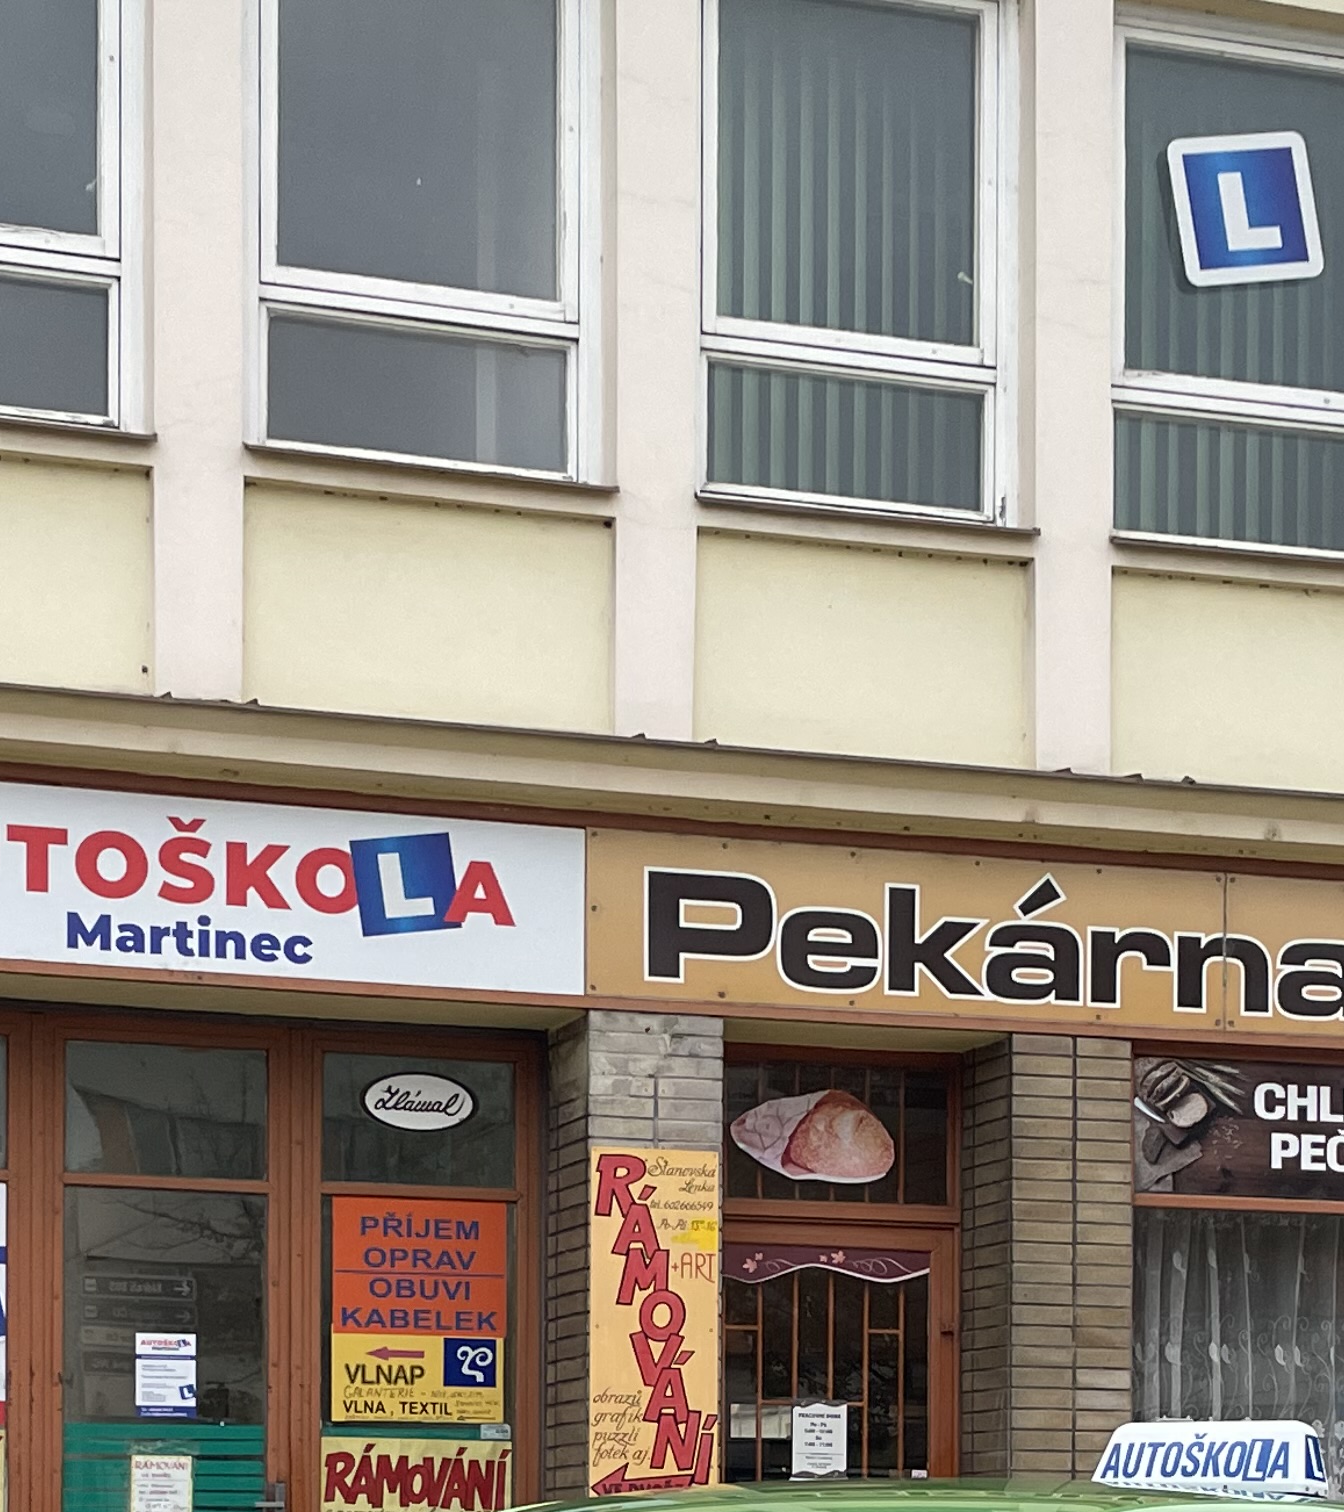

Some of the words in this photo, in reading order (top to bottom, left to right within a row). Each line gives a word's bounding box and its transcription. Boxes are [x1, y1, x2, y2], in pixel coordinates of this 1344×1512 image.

[1217, 172, 1282, 251] L
[67, 912, 313, 965] Martinec
[678, 1179, 716, 1195] Lenka
[360, 1212, 479, 1240] PŘÍJEM
[363, 1247, 476, 1271] OPRAV
[369, 1278, 471, 1300] OBUVI
[341, 1307, 497, 1331] KABELEK
[344, 1363, 425, 1386] VLNAP
[343, 1400, 386, 1414] VLNA
[399, 1401, 453, 1415] TEXTIL
[593, 1387, 643, 1407] obrazů
[591, 1406, 644, 1431] grafik
[593, 1441, 629, 1467] fotek
[1101, 1433, 1290, 1482] AUTOŠKOLA
[324, 1443, 512, 1512] RÁMOVÁNÍ
